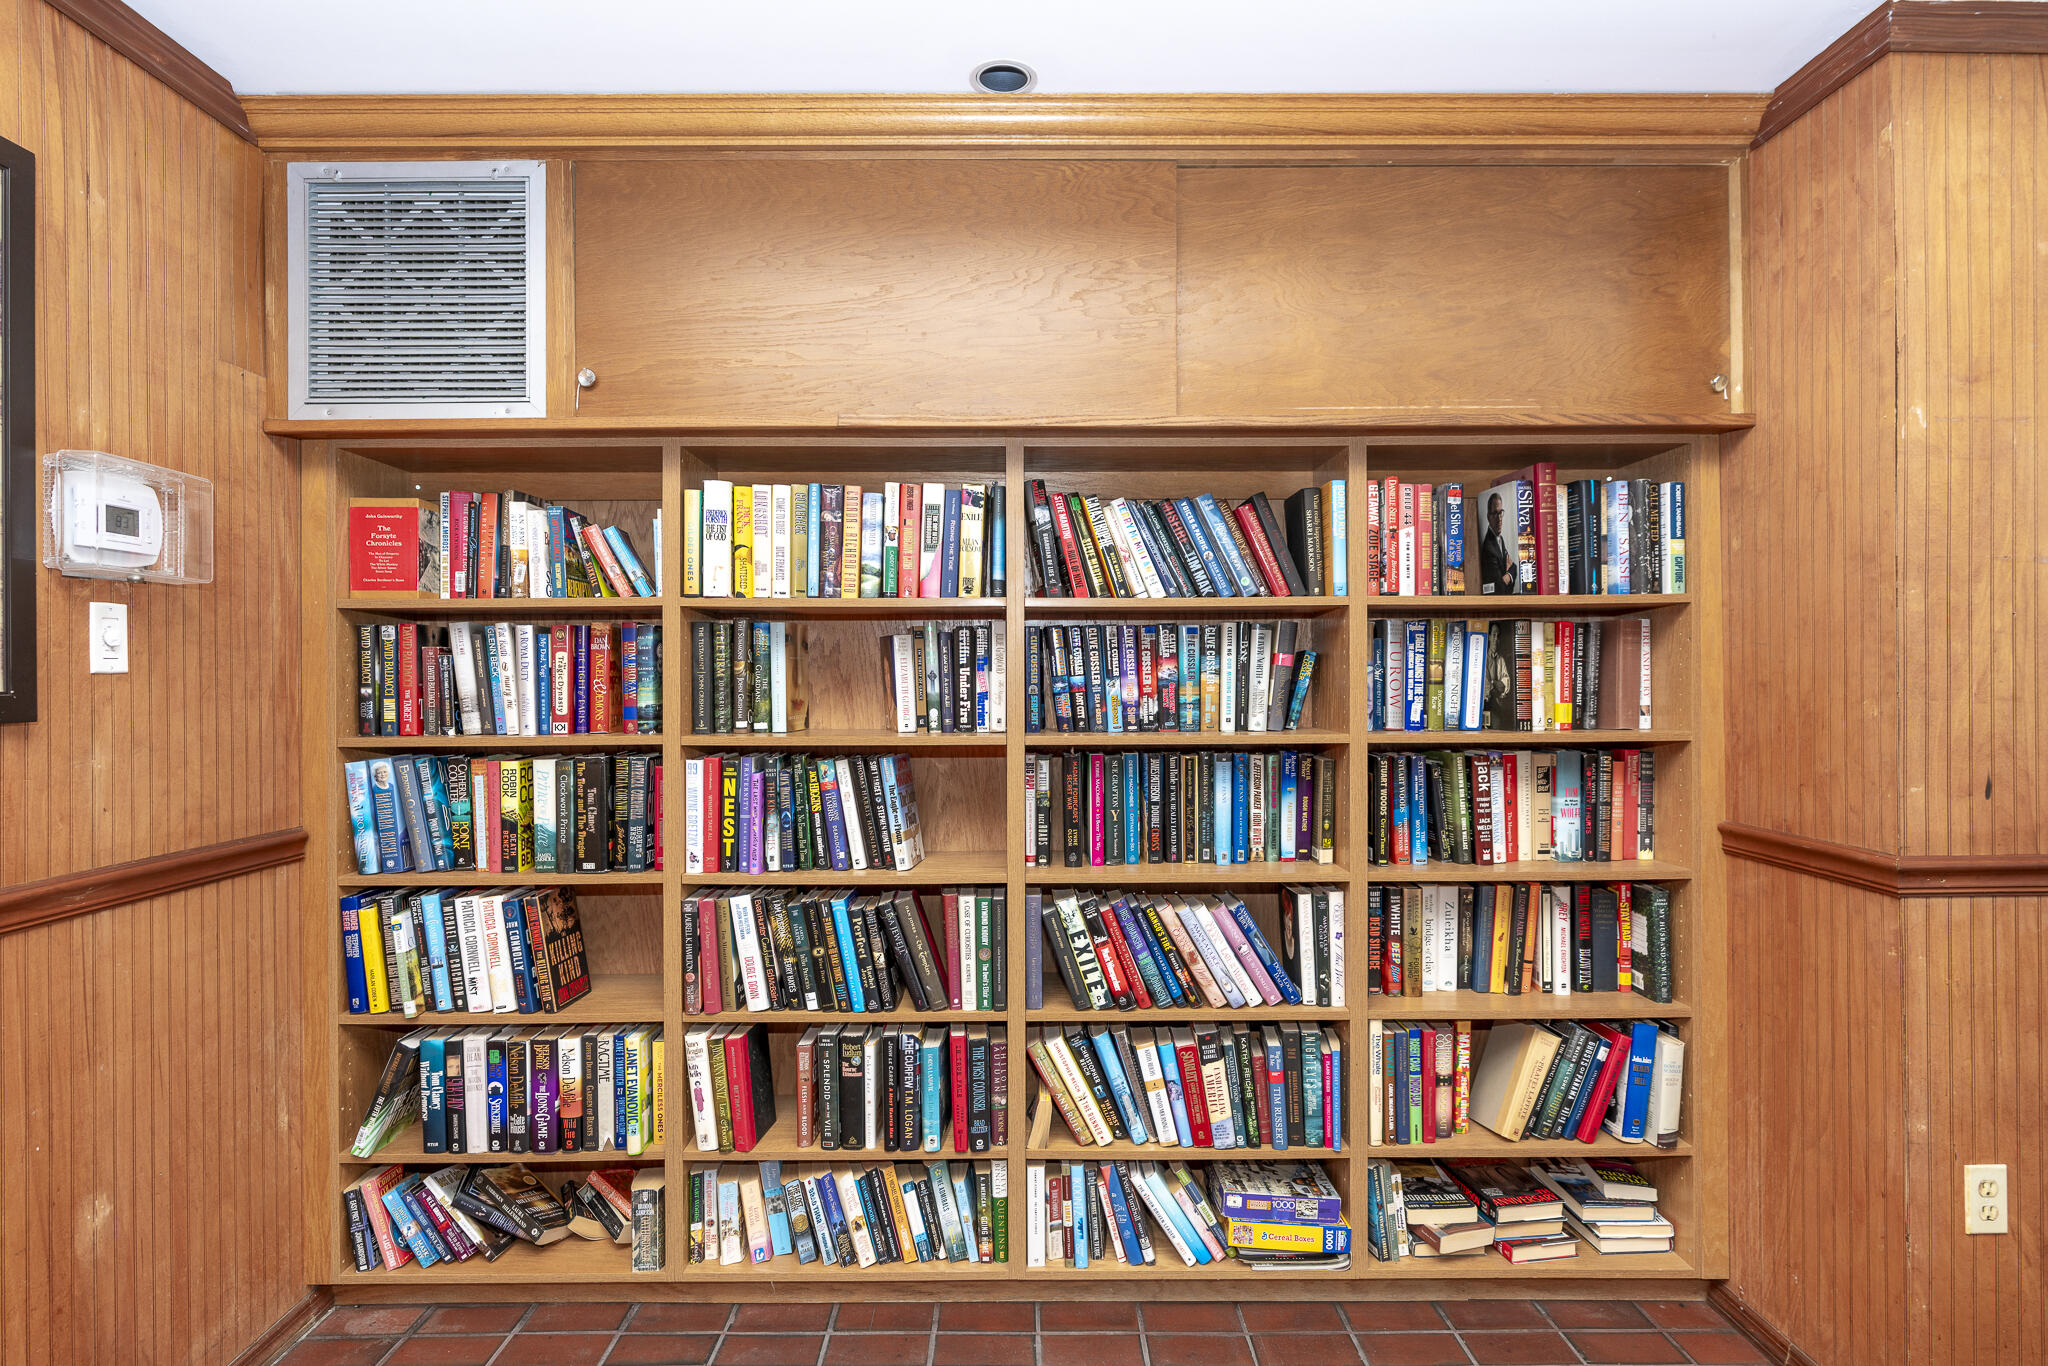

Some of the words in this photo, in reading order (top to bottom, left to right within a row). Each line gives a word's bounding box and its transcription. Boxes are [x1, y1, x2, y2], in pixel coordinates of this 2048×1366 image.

[441, 495, 450, 520] STEPHEN
[1369, 484, 1380, 526] GETAWAY
[1404, 487, 1412, 509] CHILD
[1518, 490, 1533, 527] Silva
[1617, 493, 1630, 523] BEN
[551, 517, 560, 534] DAVID
[795, 492, 807, 536] COMEBACK
[961, 512, 983, 521] EXILE
[1087, 497, 1113, 548] CATASTROPHE
[1162, 501, 1189, 543] MISFIRE
[1306, 509, 1314, 536] SHARRI
[365, 540, 403, 548] Chronicles
[371, 533, 397, 541] Forsyte
[441, 526, 450, 552] AMBROSE
[713, 533, 727, 541] GOD
[1369, 529, 1380, 550] ZOJE
[441, 554, 450, 564] THE
[1308, 537, 1316, 572] MARKSON
[1369, 554, 1380, 582] STAGE
[1618, 537, 1630, 583] SASSE
[441, 566, 450, 579] WILD
[686, 557, 694, 581] ONES
[441, 581, 450, 593] BLUE
[361, 626, 371, 648] DAVID
[487, 627, 498, 655] GLENN
[520, 637, 528, 660] ROYAL
[628, 642, 636, 660] TOM
[1030, 635, 1039, 654] CLIVE
[361, 649, 371, 684] BALDACCI
[489, 656, 498, 678] BECK
[520, 661, 529, 682] DUTY
[1031, 654, 1039, 684] CUSSLER
[1389, 640, 1402, 710] TUROW
[628, 663, 636, 700] BROKAW
[960, 667, 971, 700] Under
[960, 701, 971, 724] Fire
[1076, 692, 1084, 706] LOST
[1077, 706, 1085, 719] CITY
[1025, 763, 1035, 774] BIG
[1025, 775, 1035, 790] PAPI
[1380, 760, 1389, 788] STUART
[1474, 760, 1491, 792] jack
[502, 768, 510, 798] COOK
[509, 768, 517, 798] ROBIN
[559, 775, 568, 816] Clockwork
[586, 788, 598, 805] Tom
[1380, 788, 1389, 816] WOODS
[559, 818, 568, 844] Prince
[586, 806, 598, 834] Clancy
[723, 778, 736, 857] NEST
[1151, 805, 1160, 829] DOUBLE
[451, 822, 460, 850] BLANK
[459, 821, 470, 850] POINT
[1152, 828, 1160, 851] CROSS
[342, 911, 350, 931] SIEGE
[350, 910, 358, 931] UNDER
[461, 900, 476, 934] PATRICIA
[1391, 905, 1401, 936] WHITE
[1620, 902, 1631, 922] STAY
[853, 917, 868, 959] Perfect
[1146, 907, 1167, 937] CHANGO'S
[1158, 937, 1173, 952] FIRE
[1369, 916, 1381, 937] DEAD
[1444, 901, 1456, 952] Zuleikha
[1621, 922, 1631, 941] MAD
[464, 935, 481, 975] CORNWELL
[509, 930, 524, 971] CONNOLLY
[550, 931, 583, 963] KILLING
[1069, 929, 1105, 993] EXILE
[1370, 938, 1380, 970] SILENCE
[559, 957, 582, 985] KIND
[510, 1044, 525, 1075] Nelson
[904, 1039, 914, 1055] THE
[1240, 1036, 1249, 1064] KATHY
[1458, 1034, 1470, 1069] MAAME
[561, 1048, 576, 1075] Nelson
[598, 1039, 611, 1084] RAGTIME
[627, 1047, 638, 1077] JANET
[904, 1055, 914, 1089] CURFEW
[1304, 1036, 1318, 1089] NIGHTEYES
[430, 1070, 445, 1086] Tom
[510, 1075, 525, 1109] DeMille
[823, 1059, 832, 1100] SPLENDID
[1244, 1067, 1253, 1098] REICHS
[430, 1086, 444, 1110] Clancy
[1273, 1086, 1282, 1105] TIM
[563, 1119, 577, 1129] Wild
[564, 1129, 576, 1139] Fire
[824, 1119, 832, 1137] VILE
[905, 1109, 914, 1139] LOGAN
[1274, 1106, 1284, 1145] RUSSERT
[1272, 1200, 1296, 1209] 1000
[997, 1199, 1006, 1250] QUENTINS
[1268, 1233, 1293, 1242] Cereal
[1293, 1234, 1315, 1243] Boxes
[1325, 1230, 1334, 1250] 1000
